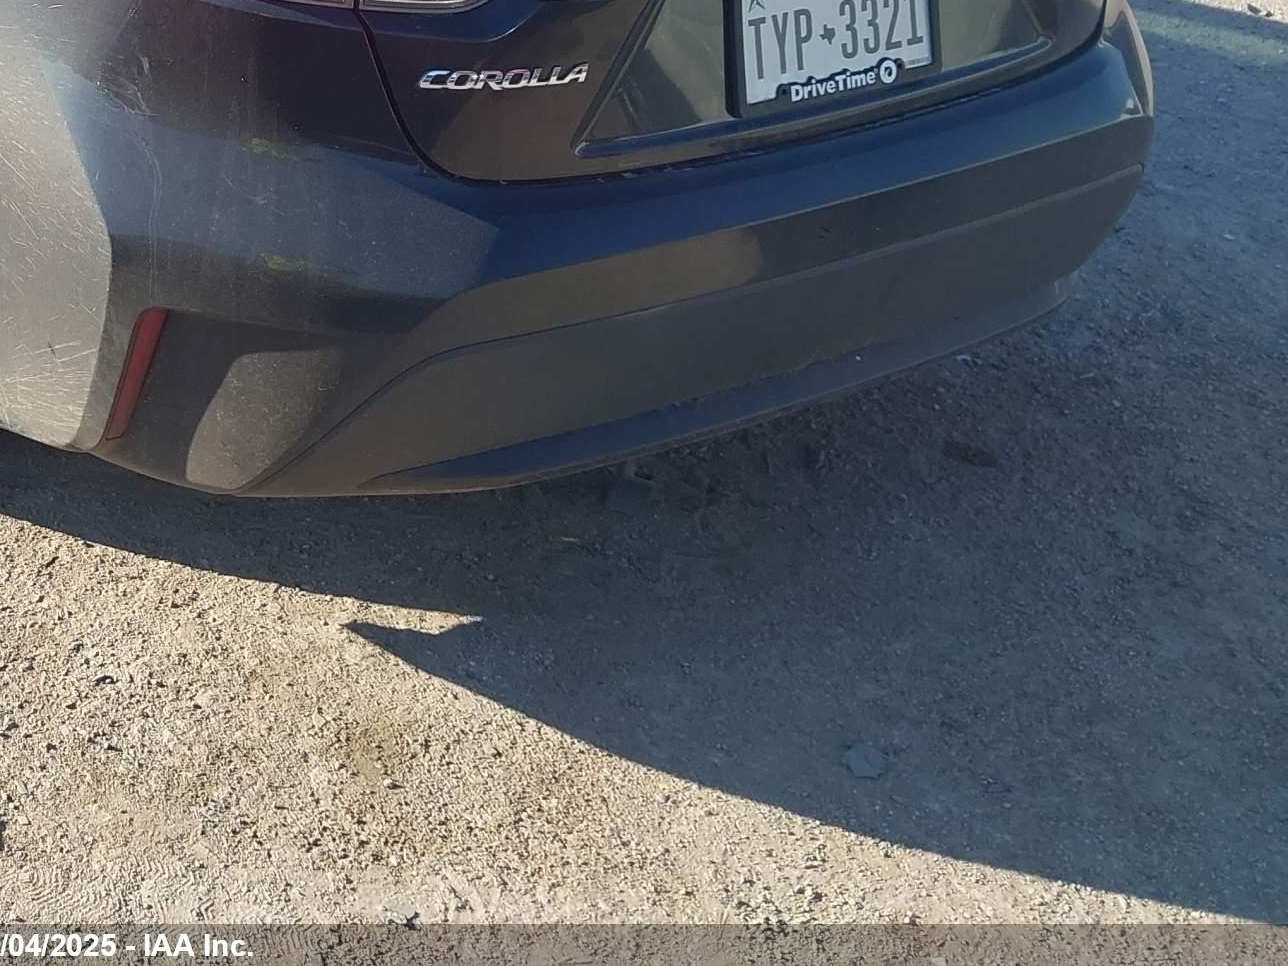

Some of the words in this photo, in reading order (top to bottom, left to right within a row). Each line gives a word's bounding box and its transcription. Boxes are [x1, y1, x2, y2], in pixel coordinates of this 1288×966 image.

[748, 8, 813, 80] TYP
[419, 61, 589, 91] COROLLA
[791, 70, 877, 102] DriveTime
